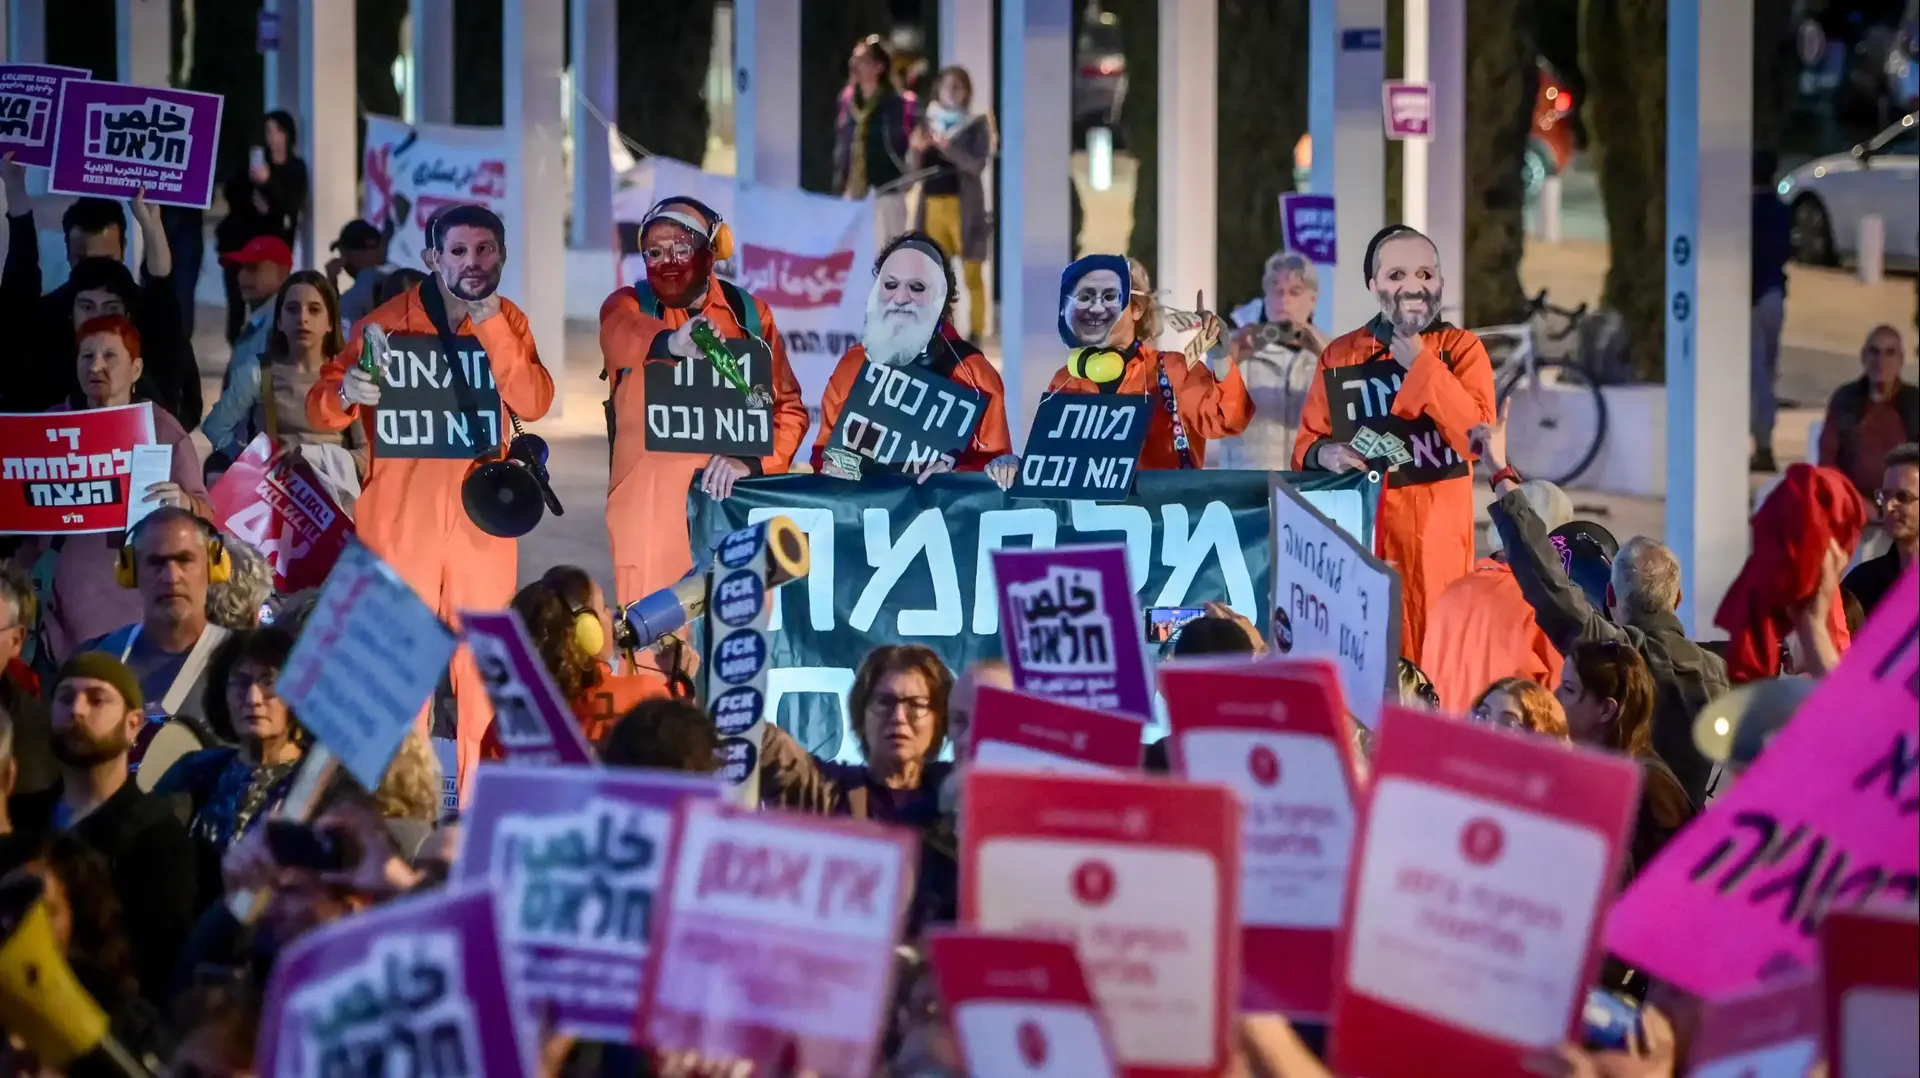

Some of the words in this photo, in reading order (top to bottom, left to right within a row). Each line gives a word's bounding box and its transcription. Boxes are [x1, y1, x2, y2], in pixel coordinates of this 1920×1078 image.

[104, 104, 187, 133] خلص
[864, 362, 929, 417] כסף
[376, 410, 434, 445] נכס
[443, 410, 498, 447] הא
[648, 404, 705, 441] נכס
[715, 408, 769, 443] הוא
[922, 390, 977, 437] רק
[1048, 403, 1137, 441] מוות
[46, 427, 81, 450] די
[842, 411, 902, 465] נכס
[2, 448, 133, 480] למלחמת
[1022, 454, 1078, 487] נכס
[1082, 457, 1135, 489] הוא
[30, 480, 113, 507] הנצח
[721, 575, 755, 601] FCK
[721, 635, 757, 658] FCK
[717, 692, 756, 712] FCK
